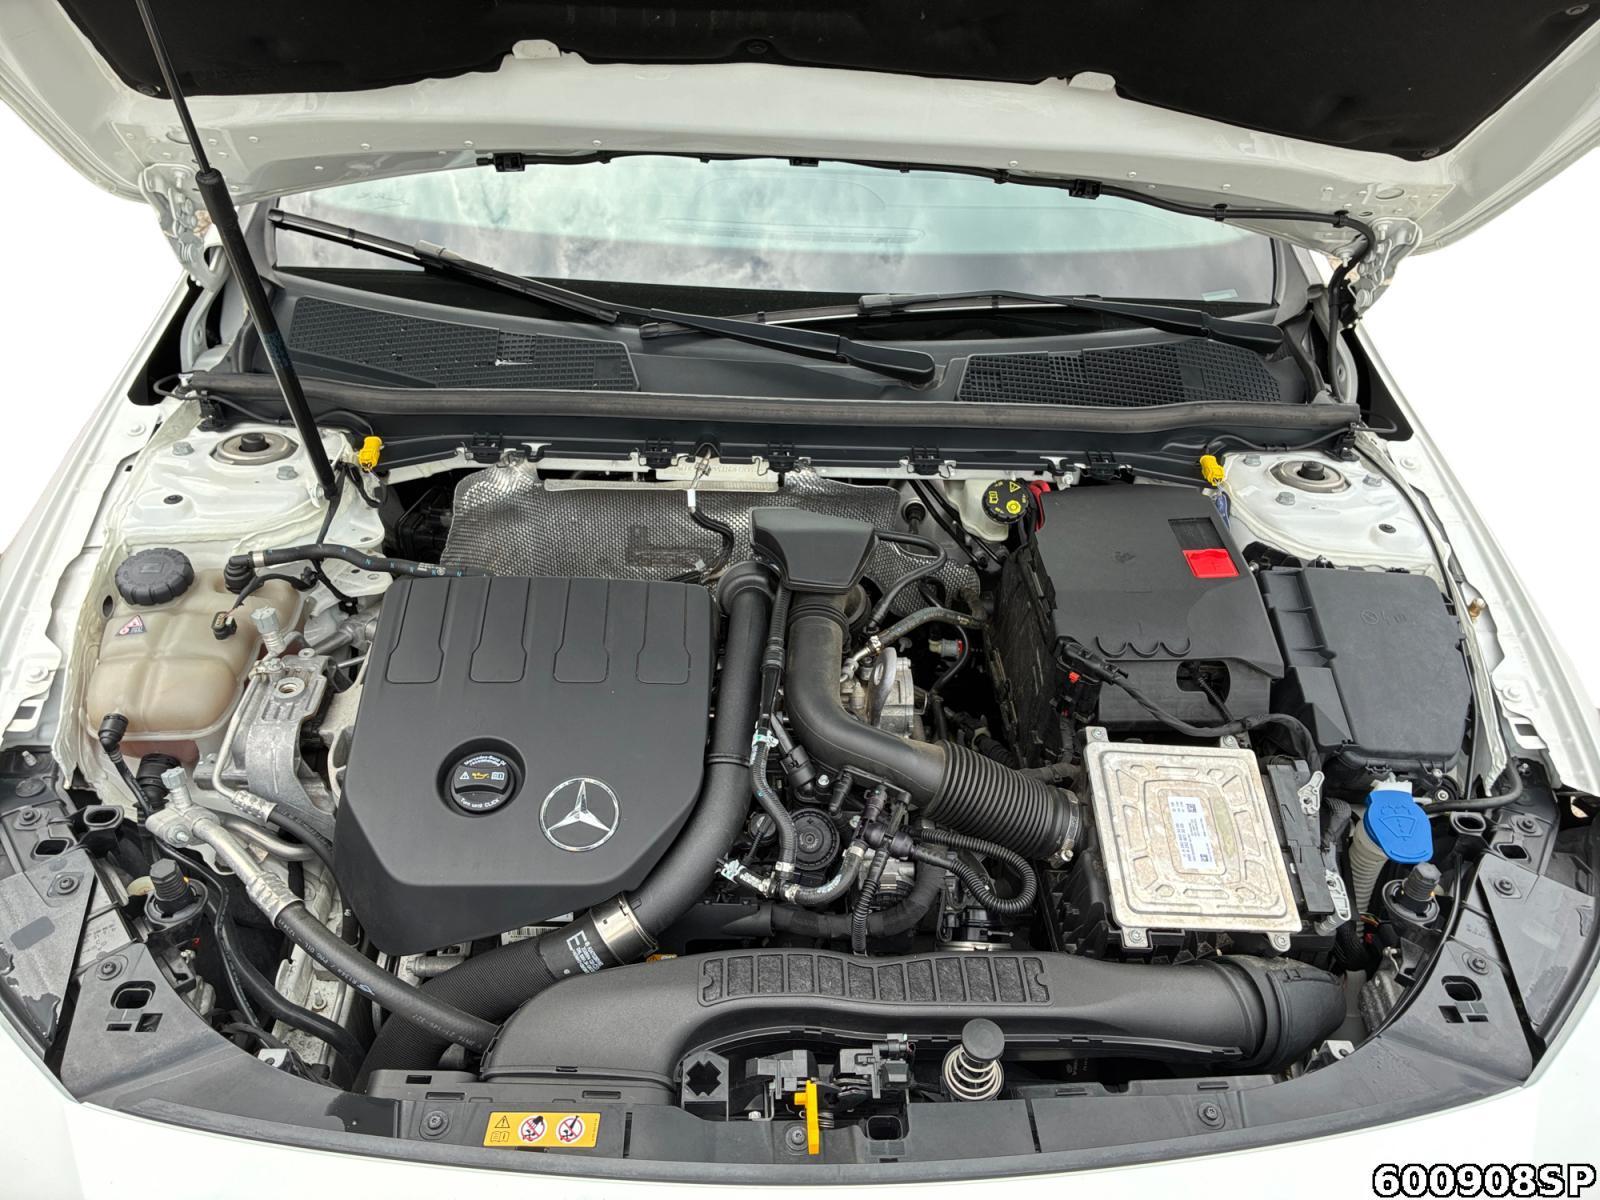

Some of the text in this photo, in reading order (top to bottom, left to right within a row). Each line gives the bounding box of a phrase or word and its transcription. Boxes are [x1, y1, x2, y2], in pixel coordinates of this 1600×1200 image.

[460, 797, 471, 806] Turn
[484, 798, 500, 808] CLICK
[304, 942, 315, 953] OIL
